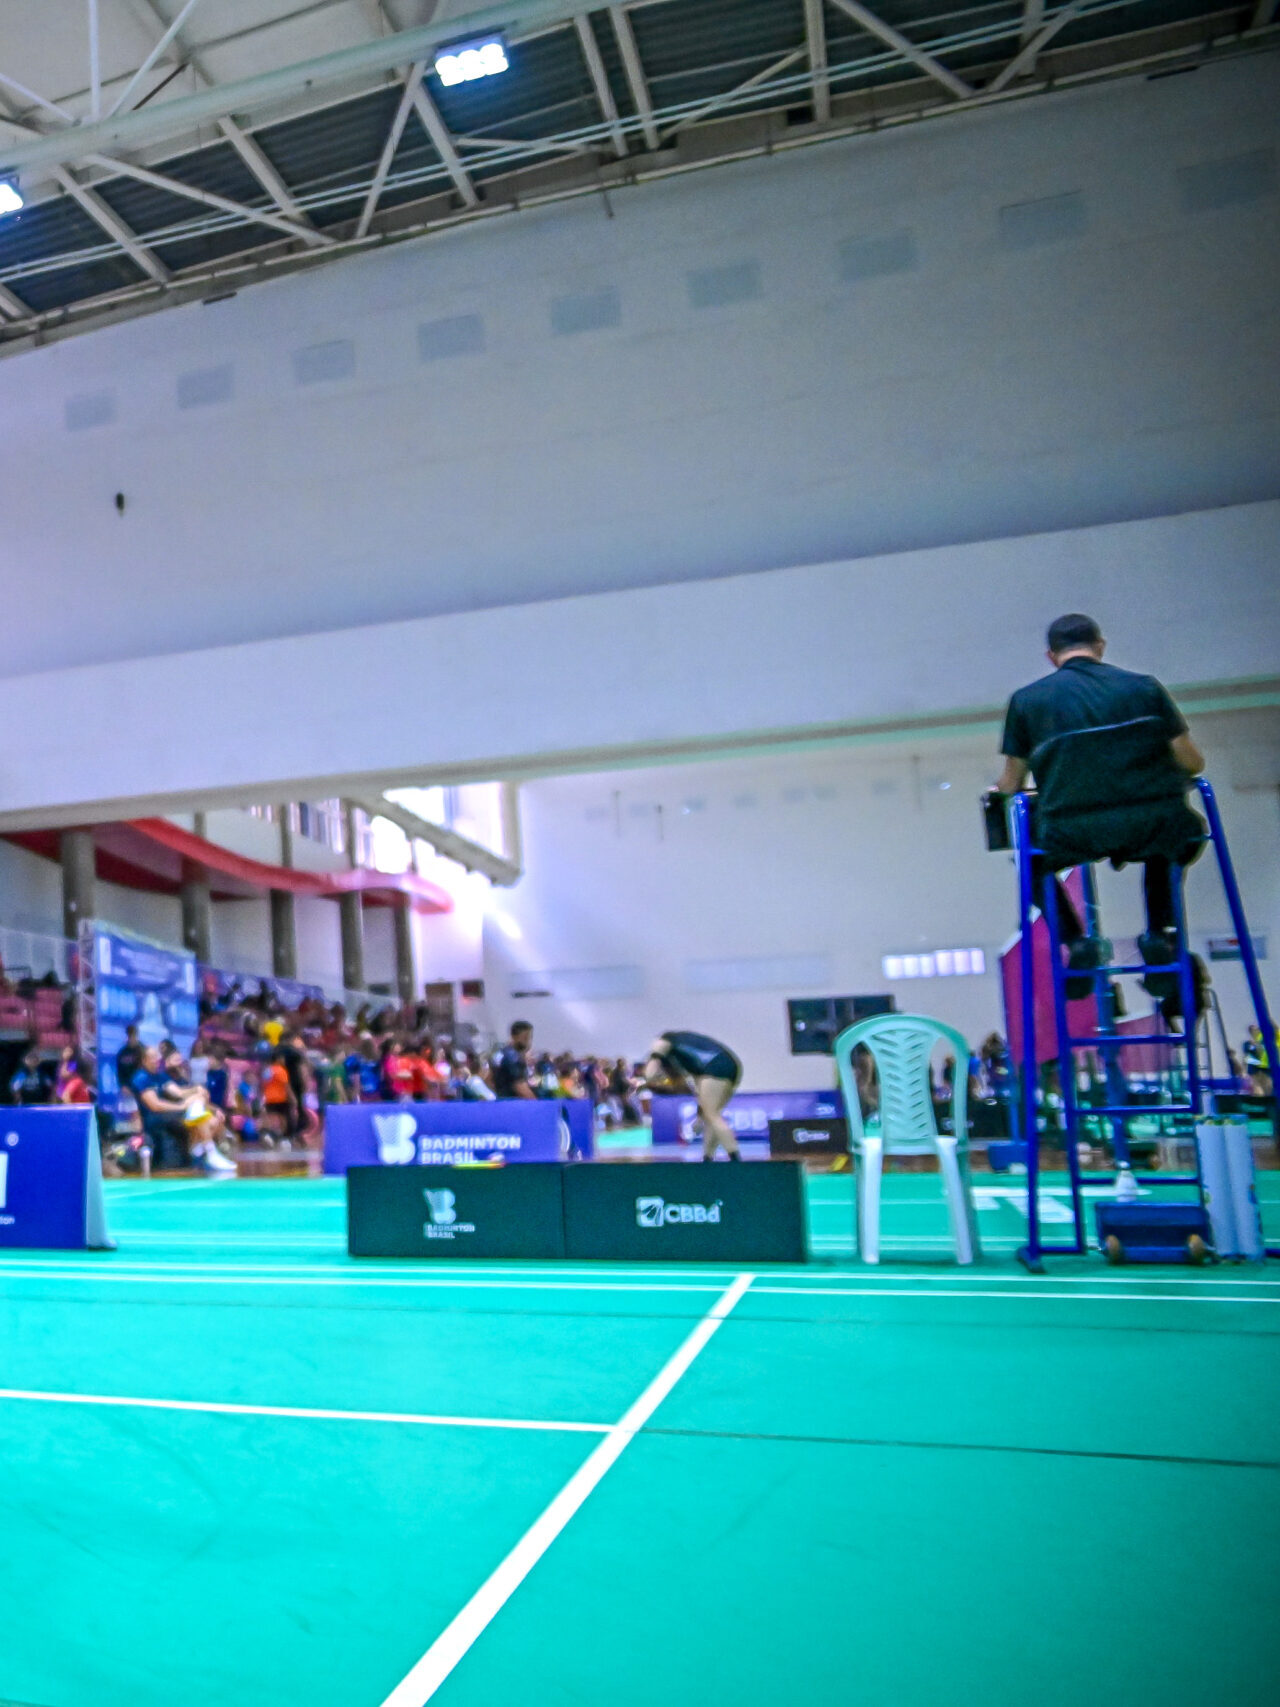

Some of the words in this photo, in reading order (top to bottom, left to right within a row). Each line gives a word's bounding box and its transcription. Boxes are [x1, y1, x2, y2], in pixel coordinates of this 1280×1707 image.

[421, 1136, 521, 1150] BADMINTON
[421, 1151, 479, 1165] BRASIL
[665, 1203, 720, 1223] CBBd
[427, 1224, 475, 1232] BADMINTON
